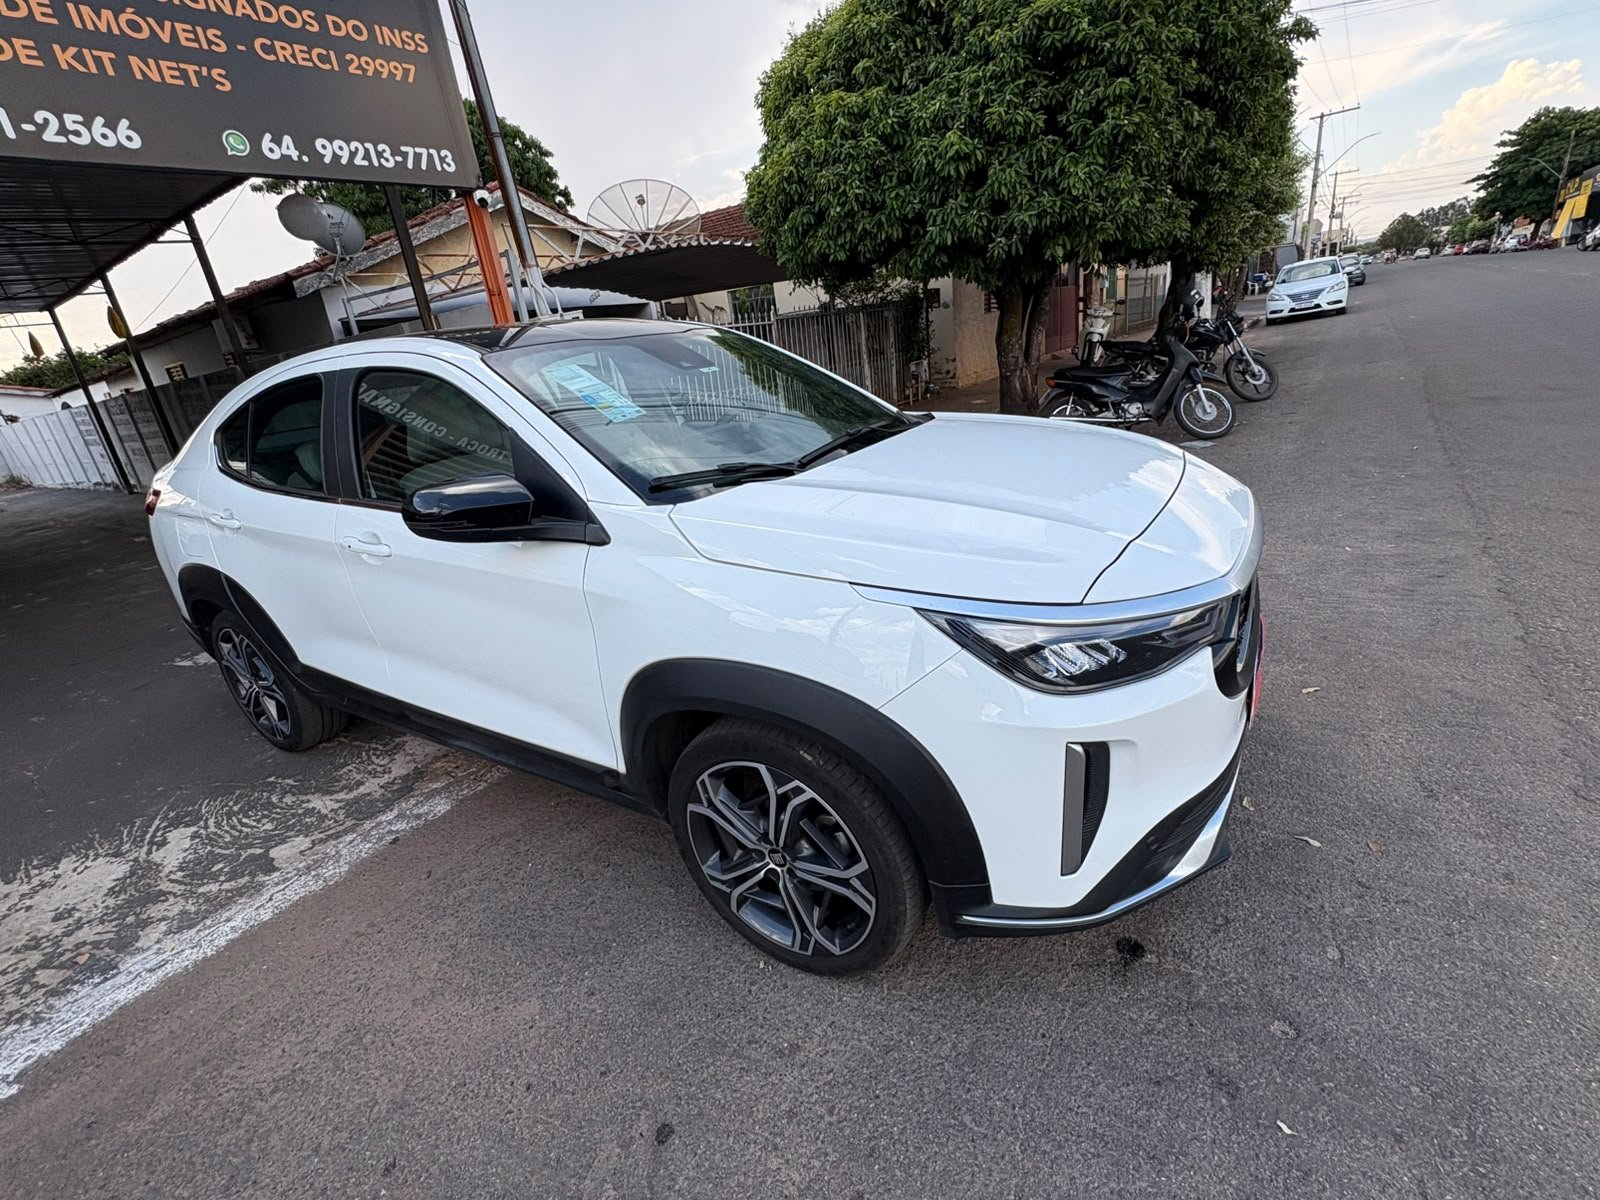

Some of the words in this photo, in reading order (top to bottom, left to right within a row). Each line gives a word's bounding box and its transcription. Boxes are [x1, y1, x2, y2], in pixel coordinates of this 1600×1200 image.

[0, 0, 59, 25] DE
[66, 2, 228, 53] IMÓVEIS
[253, 37, 340, 71] CRECI
[345, 53, 416, 84] 29997
[325, 14, 368, 42] DO
[374, 24, 429, 54] INSS
[52, 43, 116, 77] KIT
[127, 54, 232, 92] NET'S
[261, 132, 309, 163] 64.
[315, 137, 456, 173] 99213-7713
